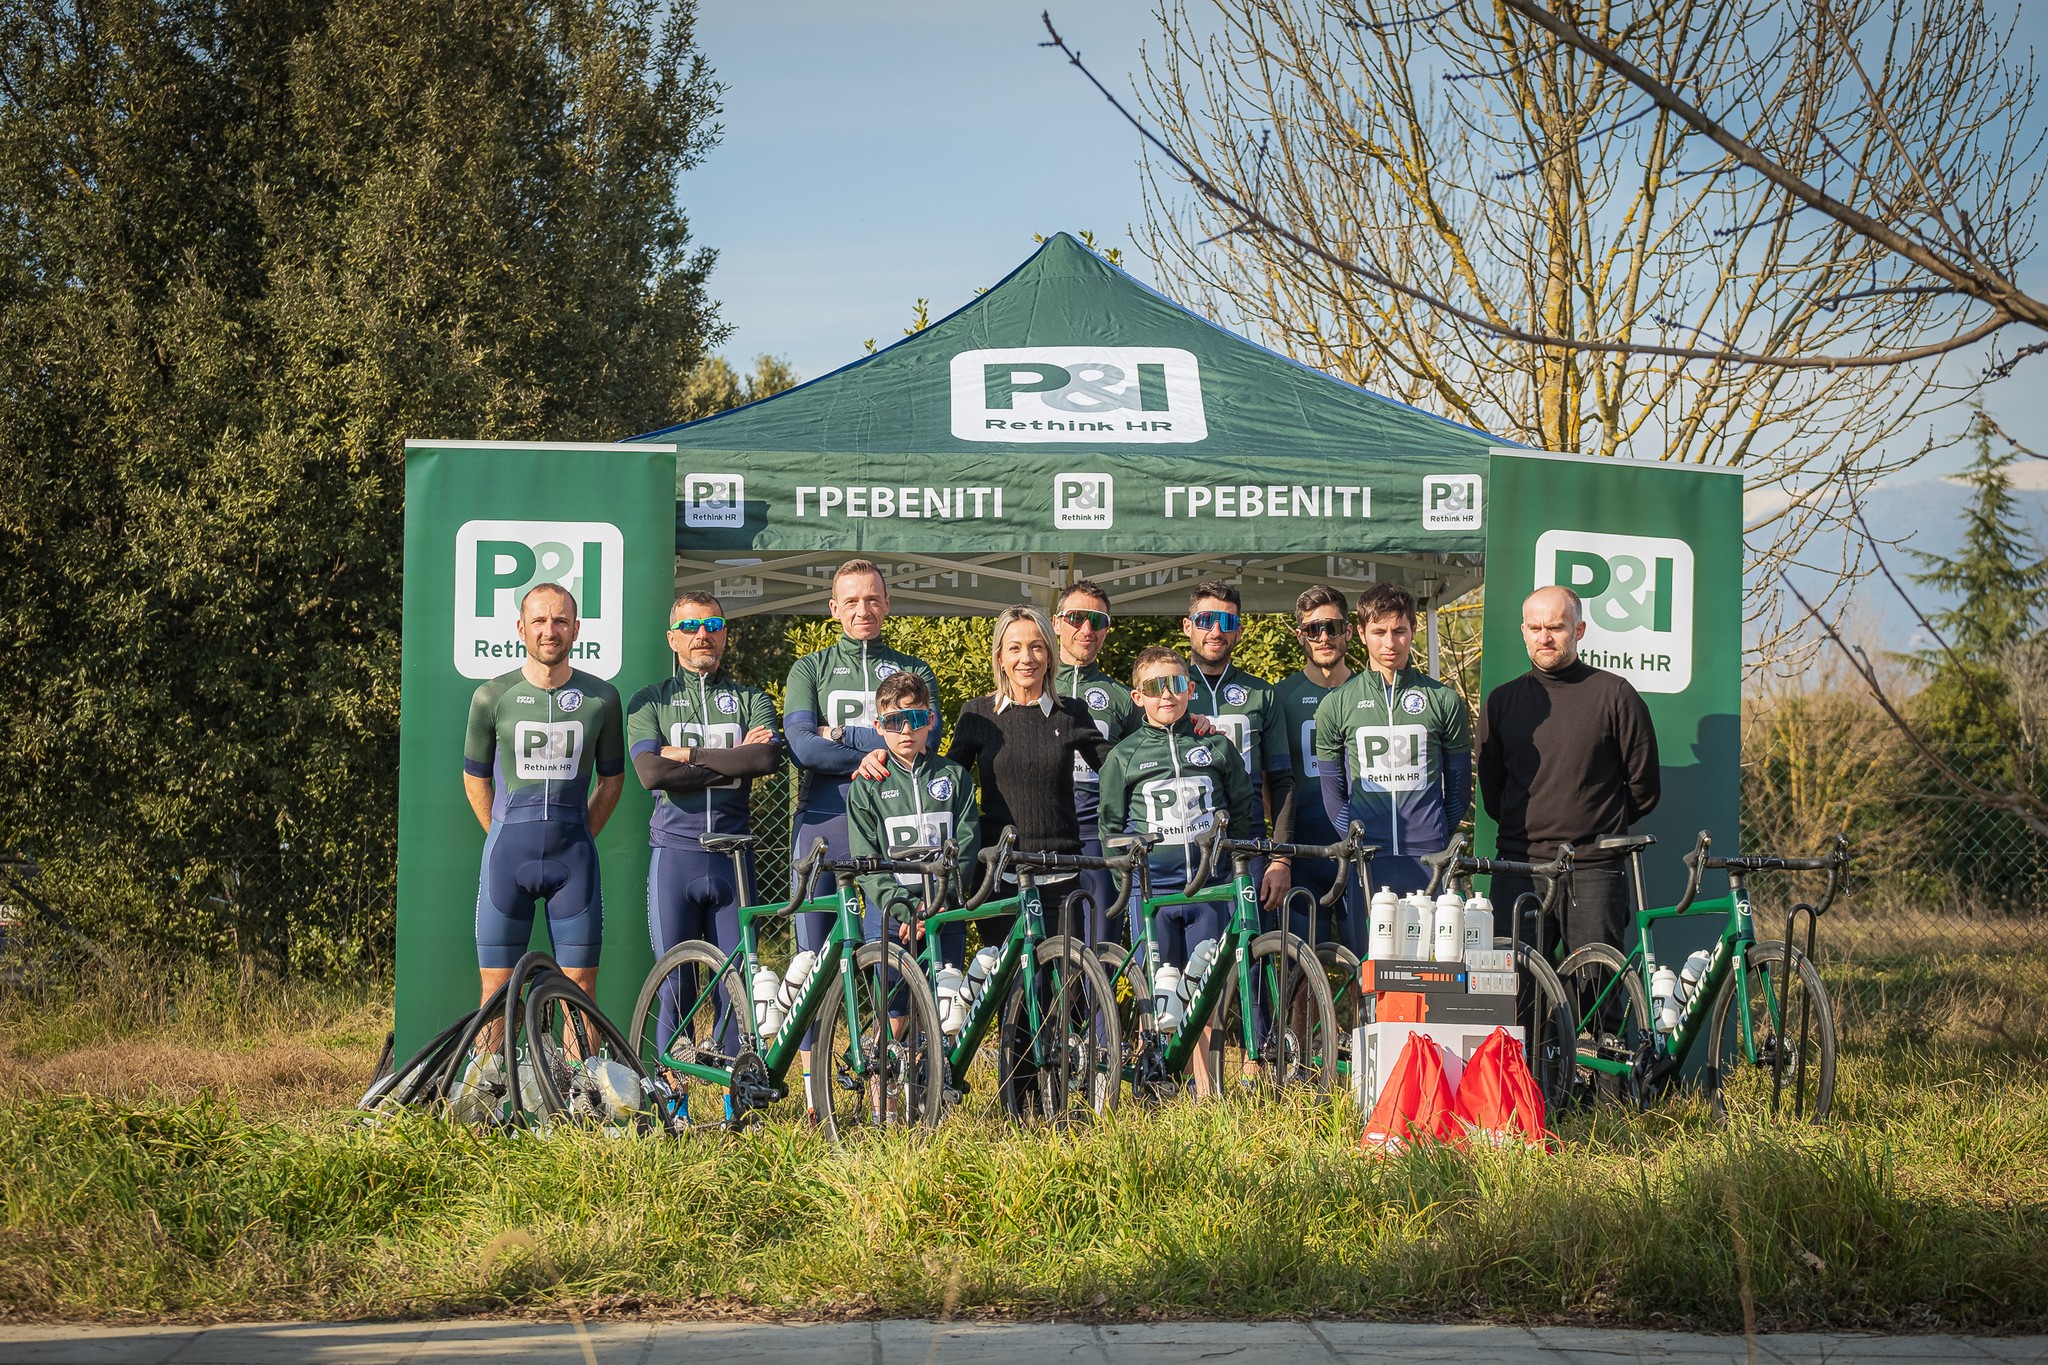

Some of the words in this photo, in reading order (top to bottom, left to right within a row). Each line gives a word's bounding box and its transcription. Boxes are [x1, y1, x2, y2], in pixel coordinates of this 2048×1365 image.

[984, 363, 1169, 413] P&I
[985, 419, 1114, 432] Rethink
[1126, 421, 1173, 432] HR
[693, 482, 736, 509] P&I
[796, 486, 1003, 519] ΓΡΕΒΕΝΙΤΙ
[1062, 481, 1105, 509] P&I
[1165, 486, 1371, 518] ΓΡΕΒΕΝΙΤΙ
[1431, 483, 1474, 510] P&I
[475, 540, 602, 619] P&I
[1555, 549, 1673, 633] P&I
[475, 640, 527, 658] Reth
[570, 642, 601, 659] HR
[1580, 649, 1633, 670] think
[1641, 653, 1671, 672] HR
[524, 730, 575, 760] P&I
[1364, 734, 1418, 769] P&I
[524, 763, 557, 771] Rethink
[559, 763, 572, 771] HR
[1368, 773, 1405, 782] Rethink
[1407, 773, 1420, 781] HR
[1151, 786, 1209, 821] P&I
[1198, 820, 1211, 830] HR
